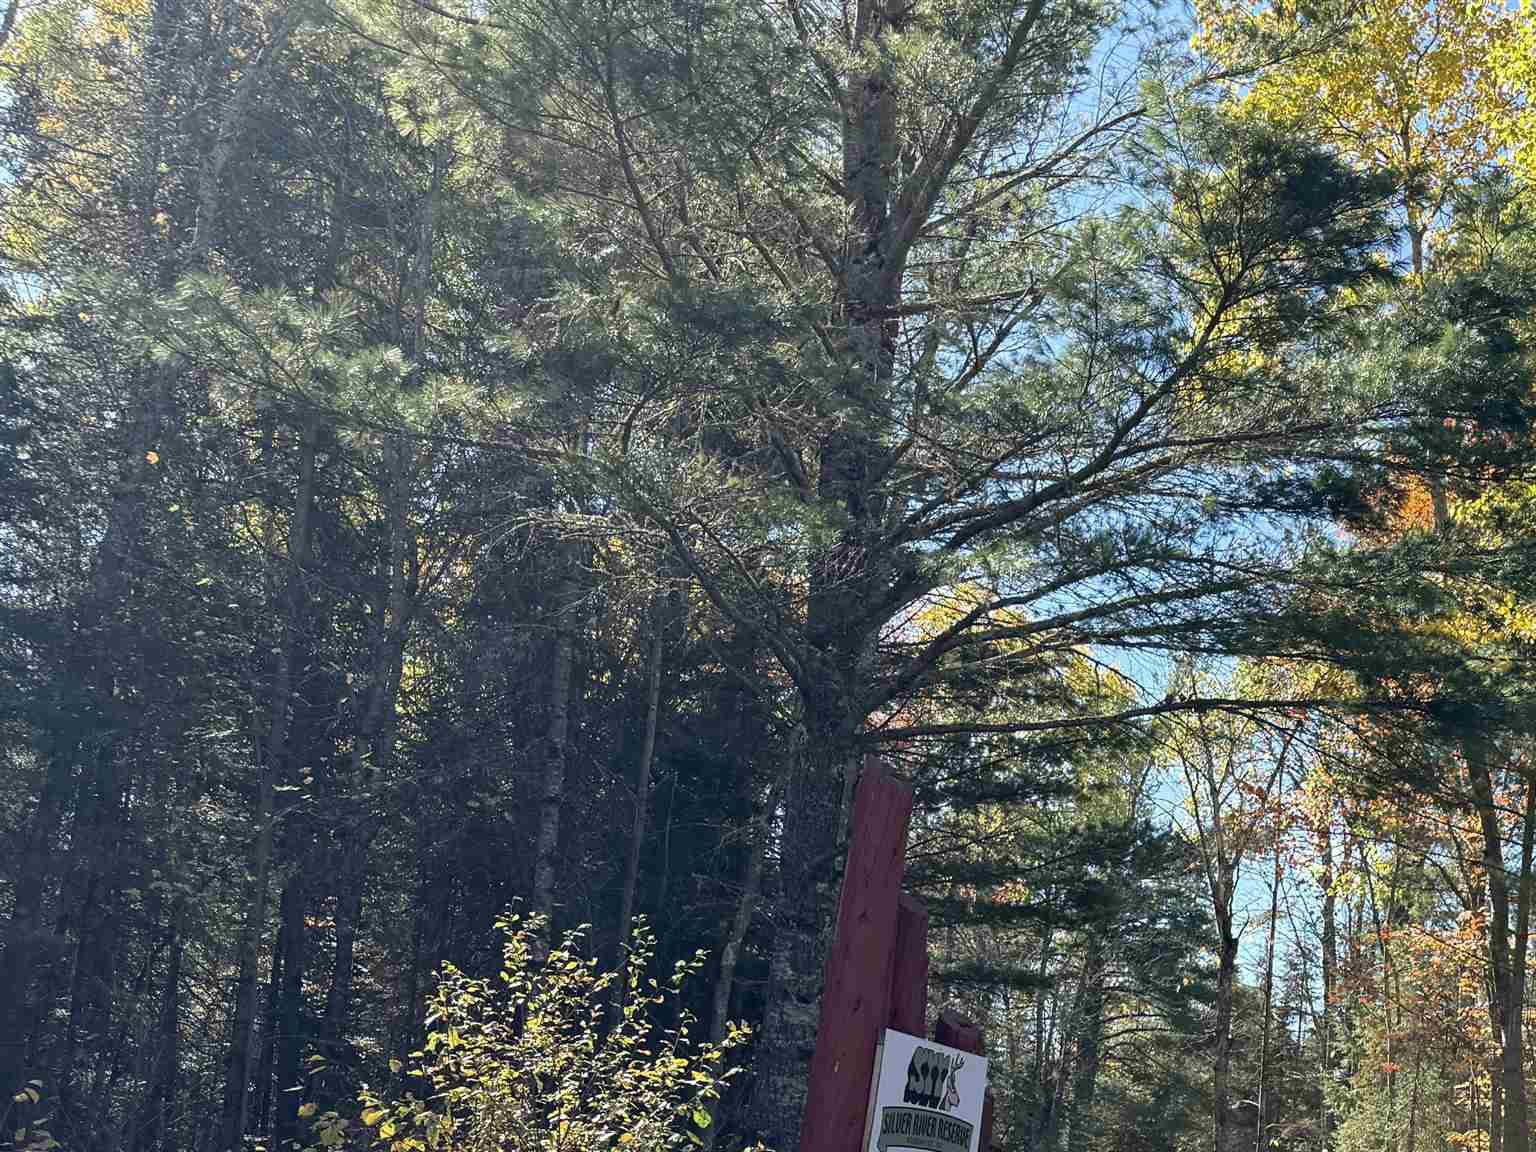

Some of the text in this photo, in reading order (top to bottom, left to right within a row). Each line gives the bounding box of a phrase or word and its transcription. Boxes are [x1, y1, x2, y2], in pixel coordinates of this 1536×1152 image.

[881, 1111, 912, 1135] SILVER
[912, 1112, 937, 1137] RIVER
[938, 1117, 970, 1149] RESERVE
